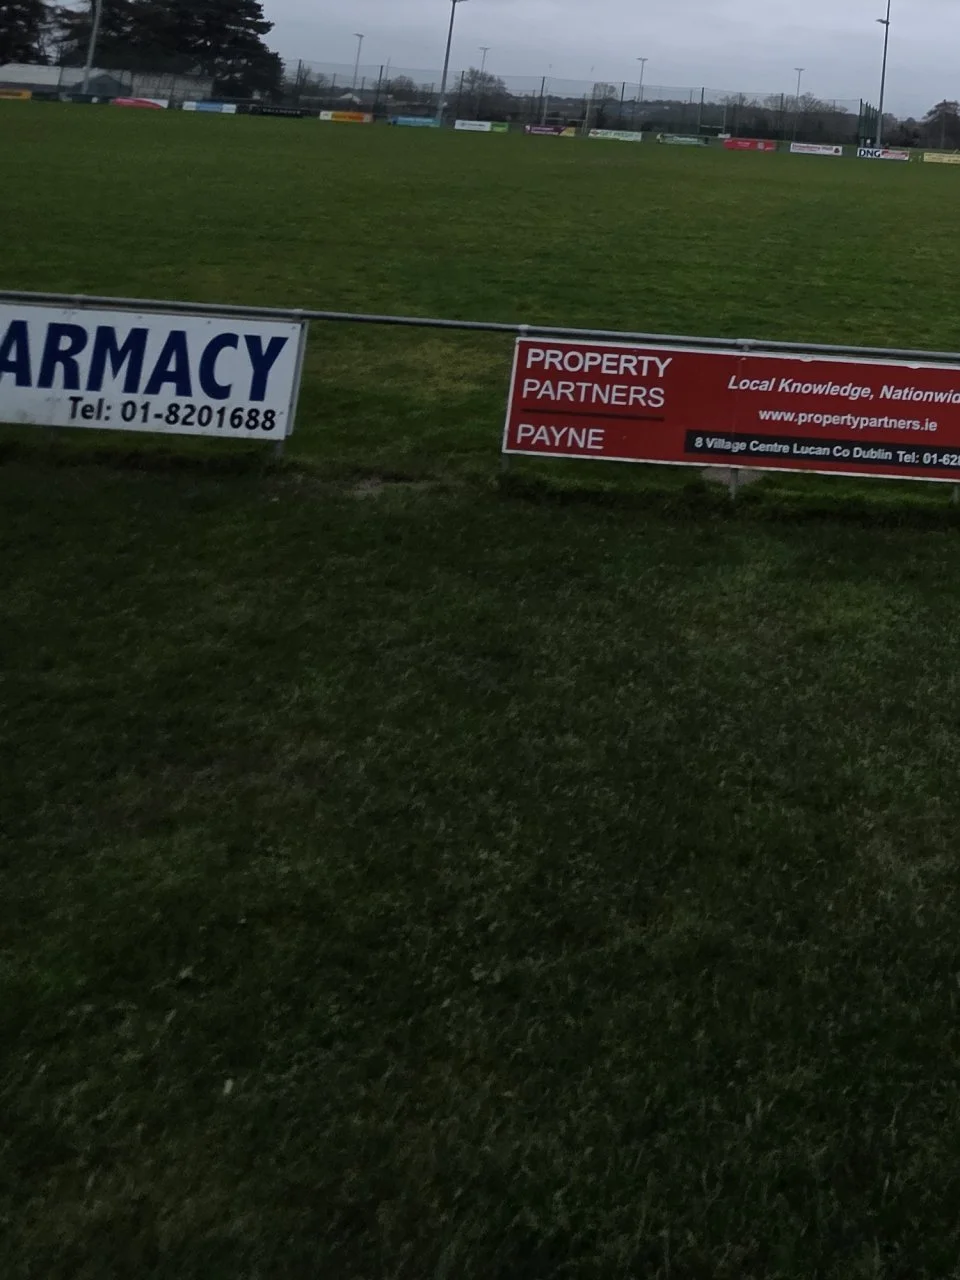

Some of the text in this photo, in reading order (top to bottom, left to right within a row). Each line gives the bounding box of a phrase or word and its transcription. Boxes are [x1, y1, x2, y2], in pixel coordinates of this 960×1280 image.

[859, 149, 881, 158] DNG
[0, 320, 288, 401] ARMACY
[526, 349, 672, 378] PROPERTY
[522, 379, 665, 408] PARTNERS
[728, 375, 776, 392] Local
[778, 377, 874, 402] Knowledge,
[68, 396, 276, 431] Tel: 01-8201688
[758, 408, 938, 432] www.propertypartners.ie
[516, 424, 605, 450] PAYNE
[695, 437, 703, 448] 8
[705, 437, 747, 453] Village
[749, 440, 790, 455] Centre
[792, 442, 831, 457] Lucan
[833, 445, 850, 458] Co
[853, 446, 893, 460] Dublin
[897, 450, 920, 464] Tel:
